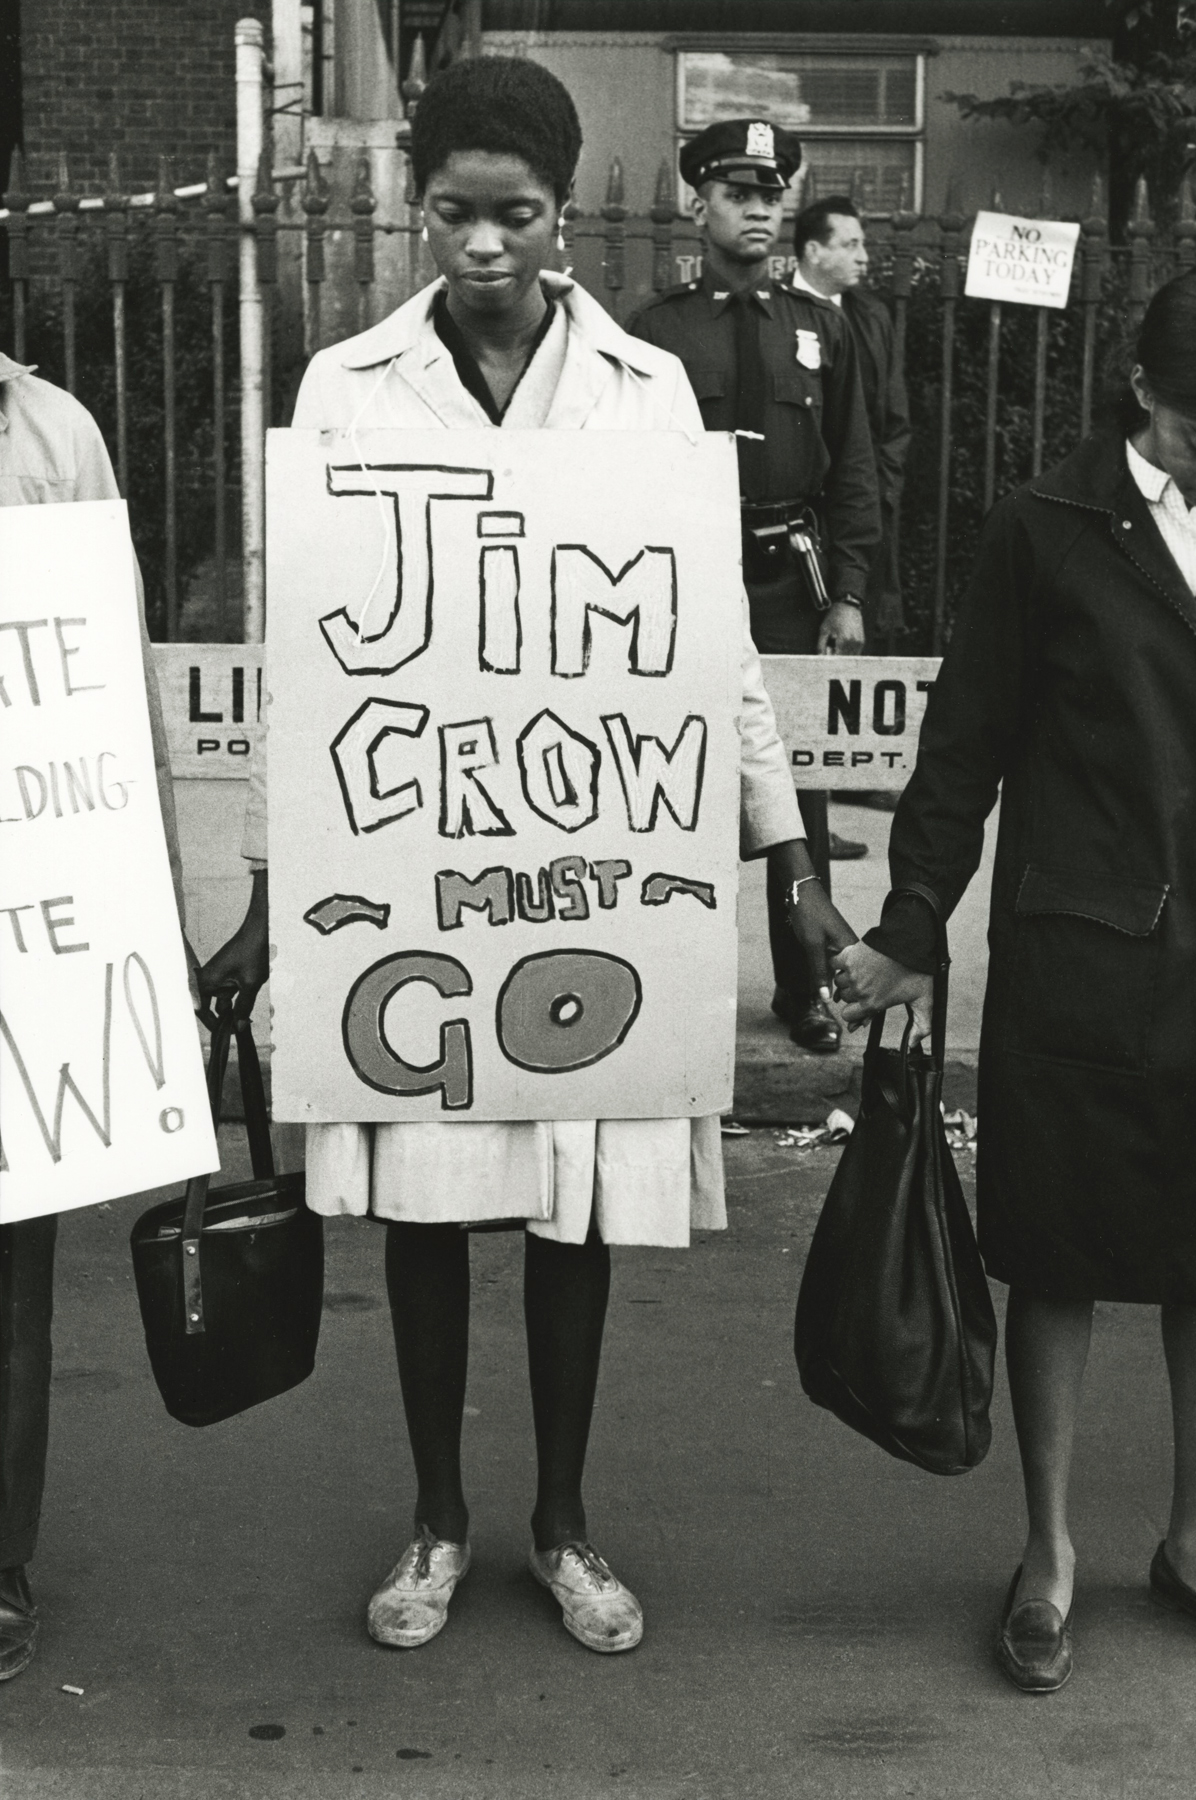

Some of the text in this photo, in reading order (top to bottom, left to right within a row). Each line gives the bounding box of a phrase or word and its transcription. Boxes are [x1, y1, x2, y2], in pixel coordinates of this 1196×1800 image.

[975, 239, 1067, 268] PARKING
[1010, 225, 1042, 244] NO
[984, 260, 1056, 285] TODAY
[189, 666, 262, 723] LI
[329, 697, 708, 838] CROW
[791, 750, 907, 768] DEPT.
[434, 856, 633, 931] MUST
[341, 948, 643, 1110] GO
[0, 951, 185, 1172] W!
